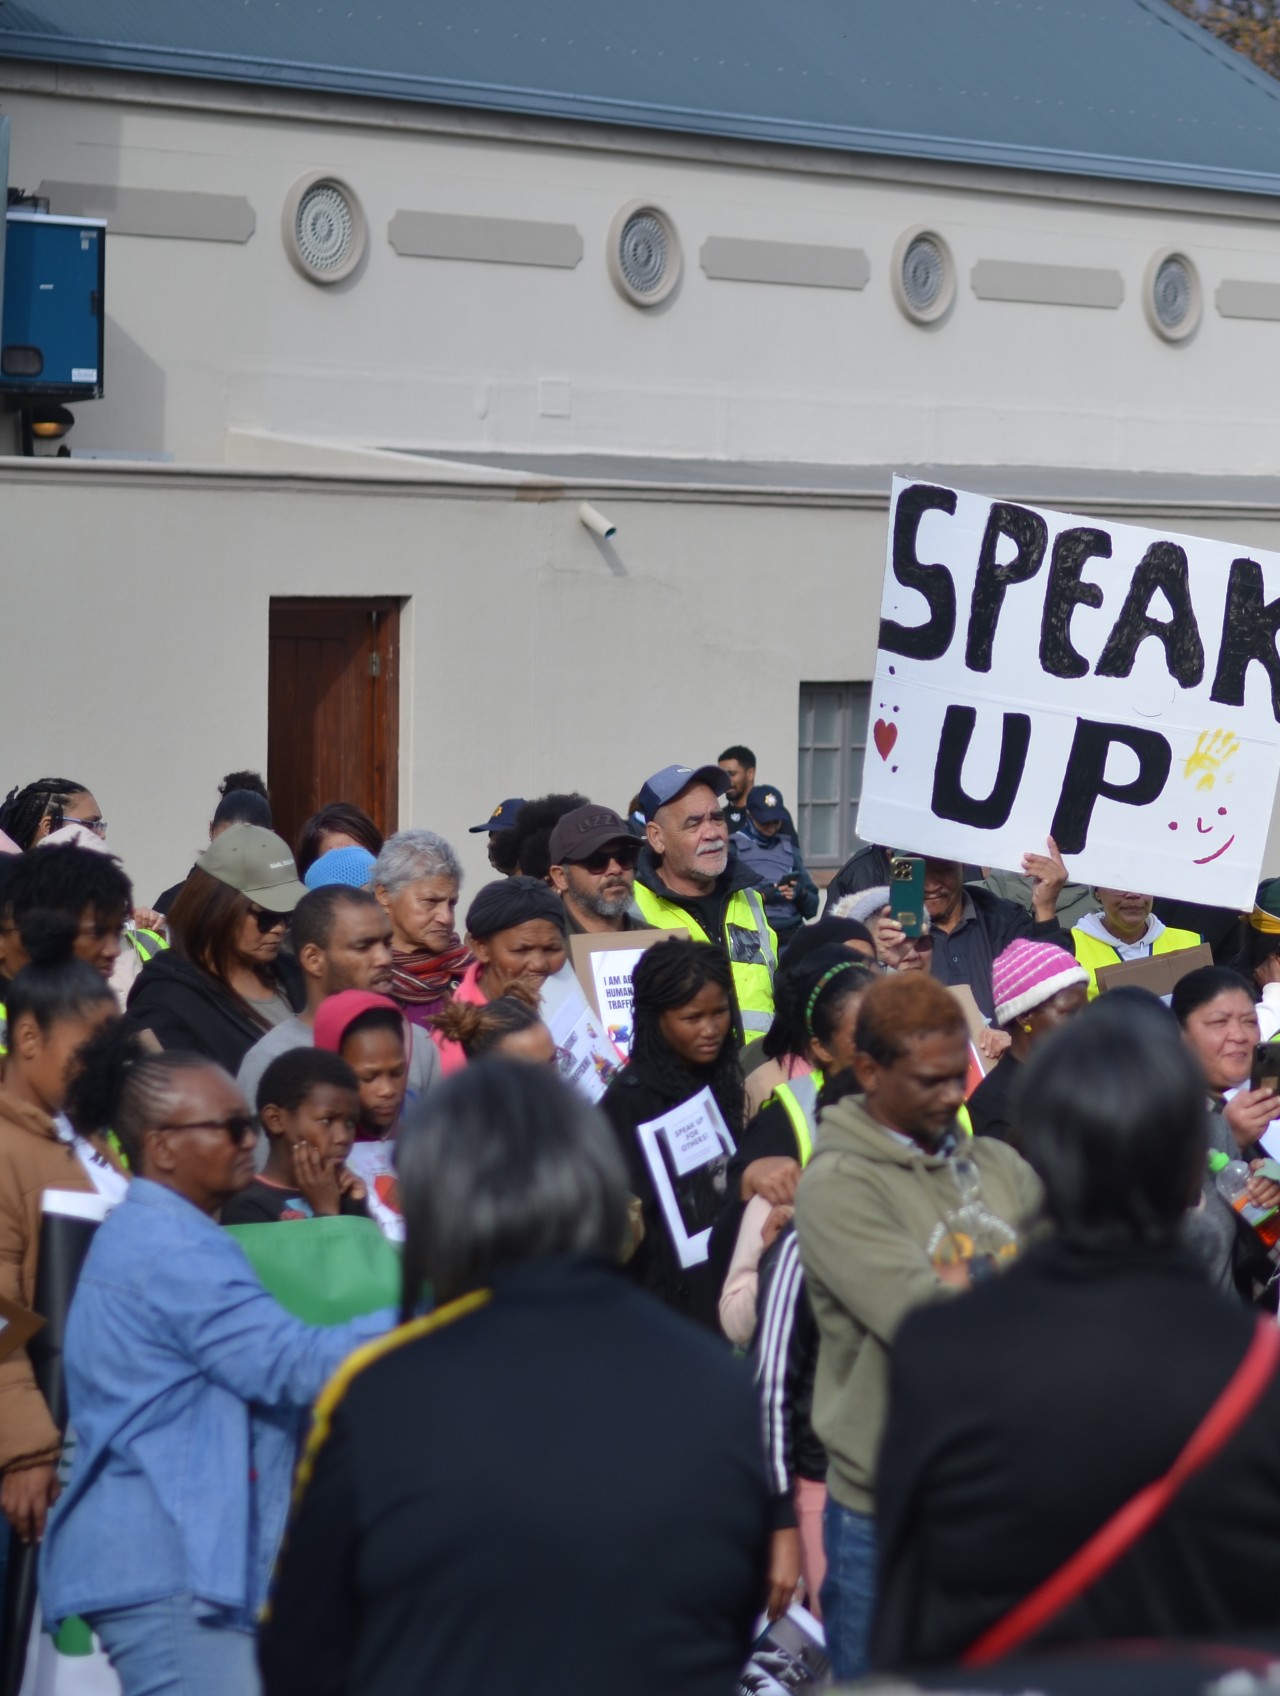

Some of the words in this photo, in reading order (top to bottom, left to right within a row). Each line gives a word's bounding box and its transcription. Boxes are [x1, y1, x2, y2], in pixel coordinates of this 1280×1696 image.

[930, 704, 1172, 855] UP
[603, 976, 607, 986] I
[608, 975, 621, 985] AM
[623, 975, 633, 984] AG
[606, 987, 633, 998] HUMAN
[675, 1122, 696, 1138] SPEAK
[686, 1129, 699, 1140] FOR
